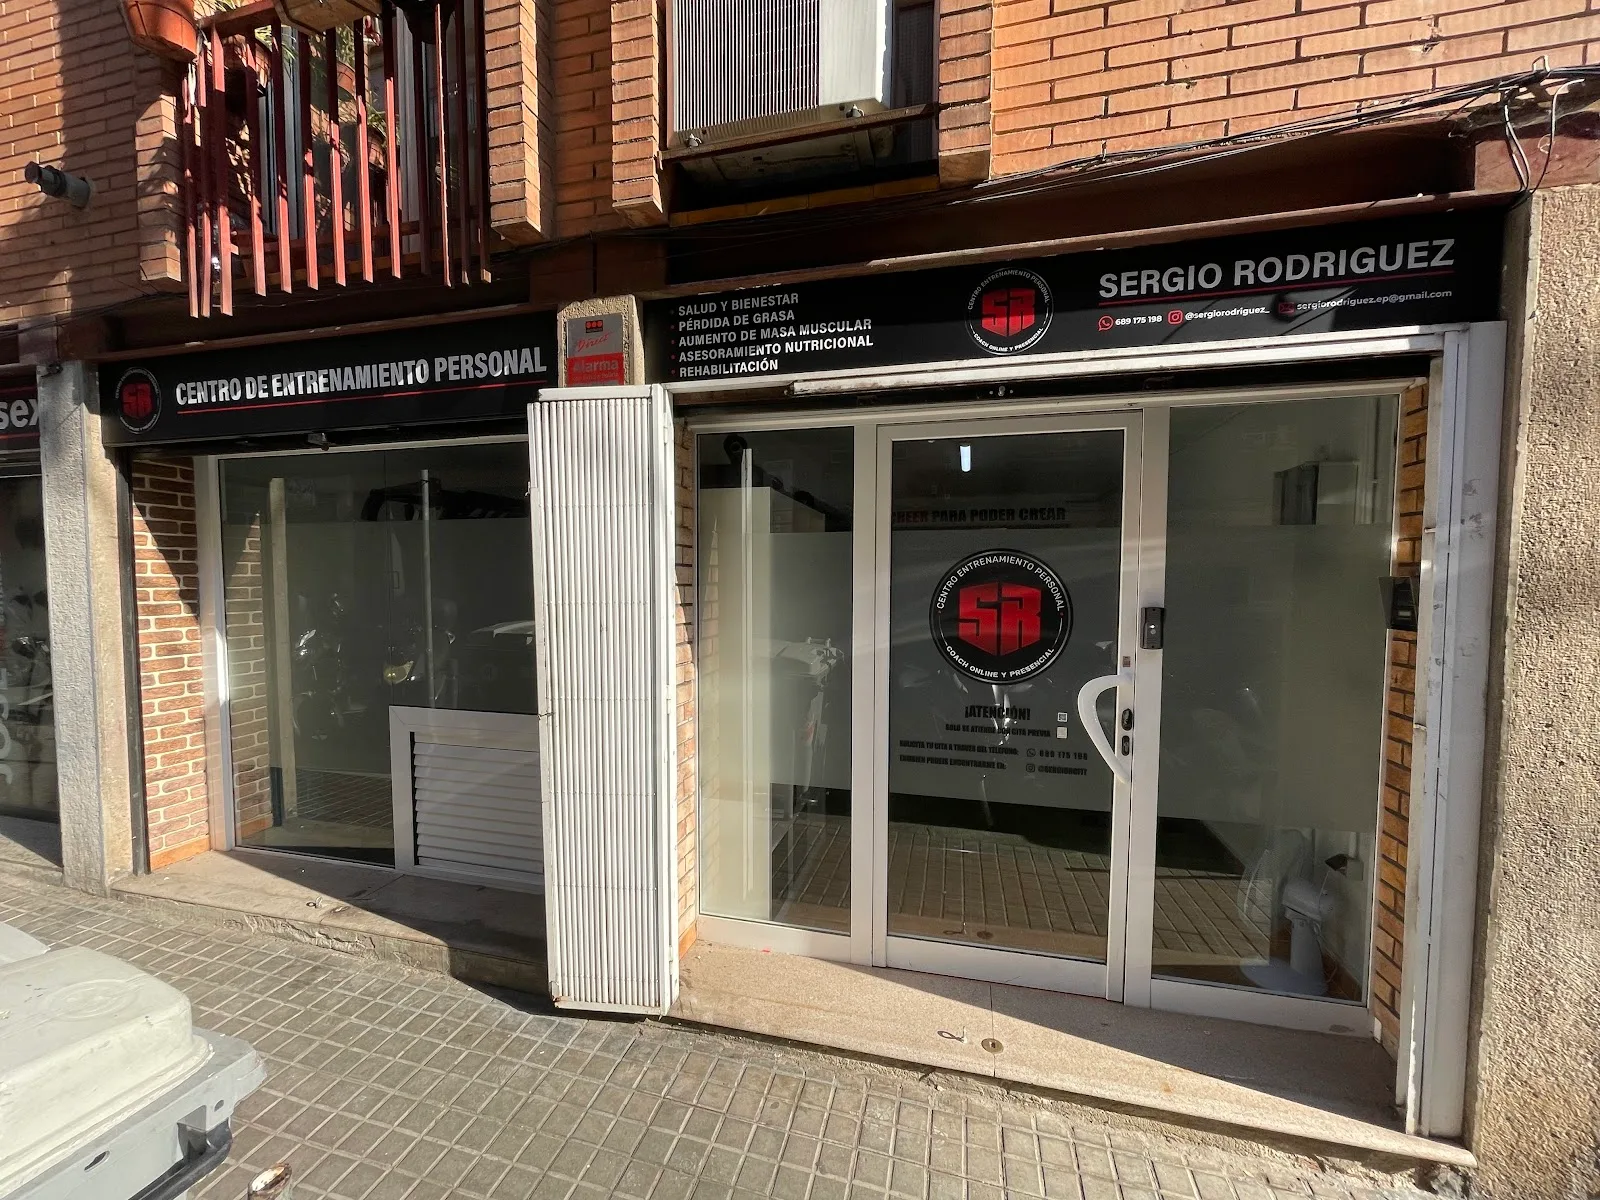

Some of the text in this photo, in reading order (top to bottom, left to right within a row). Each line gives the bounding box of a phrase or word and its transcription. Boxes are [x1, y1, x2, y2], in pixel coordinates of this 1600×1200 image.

[1098, 238, 1455, 298] SERGIO RODRIGUEZ
[968, 270, 1050, 310] CENTRO ENTRENAMIENTO PERSONAL
[1297, 290, 1452, 310] sergiorodriguez.ep@gmail.com
[678, 293, 799, 316] SALUD Y BIENESTAR
[679, 310, 795, 332] PÉRDIDA DE GRASA
[679, 319, 872, 347] AUMENTO DE MASA MUSCULAR
[1116, 315, 1162, 326] 689 175 198
[679, 335, 874, 362] ASESORAMIENTO NUTRICIONAL
[176, 378, 241, 406] CENTRO
[246, 376, 269, 400] DE
[271, 358, 430, 398] ENTRENAMIENTO
[434, 346, 548, 382] PERSONAL
[680, 358, 778, 378] REHABILITACIÓN
[932, 510, 966, 522] PARA
[970, 508, 1015, 522] PODER
[1019, 508, 1066, 520] CREAR
[936, 556, 1064, 612] CENTRO ENTRENAMIENTO PERSONAL
[958, 581, 1042, 656] SR
[946, 646, 968, 668] COACH
[970, 662, 999, 678] ONLINE
[1010, 647, 1054, 678] PRESENCIAL
